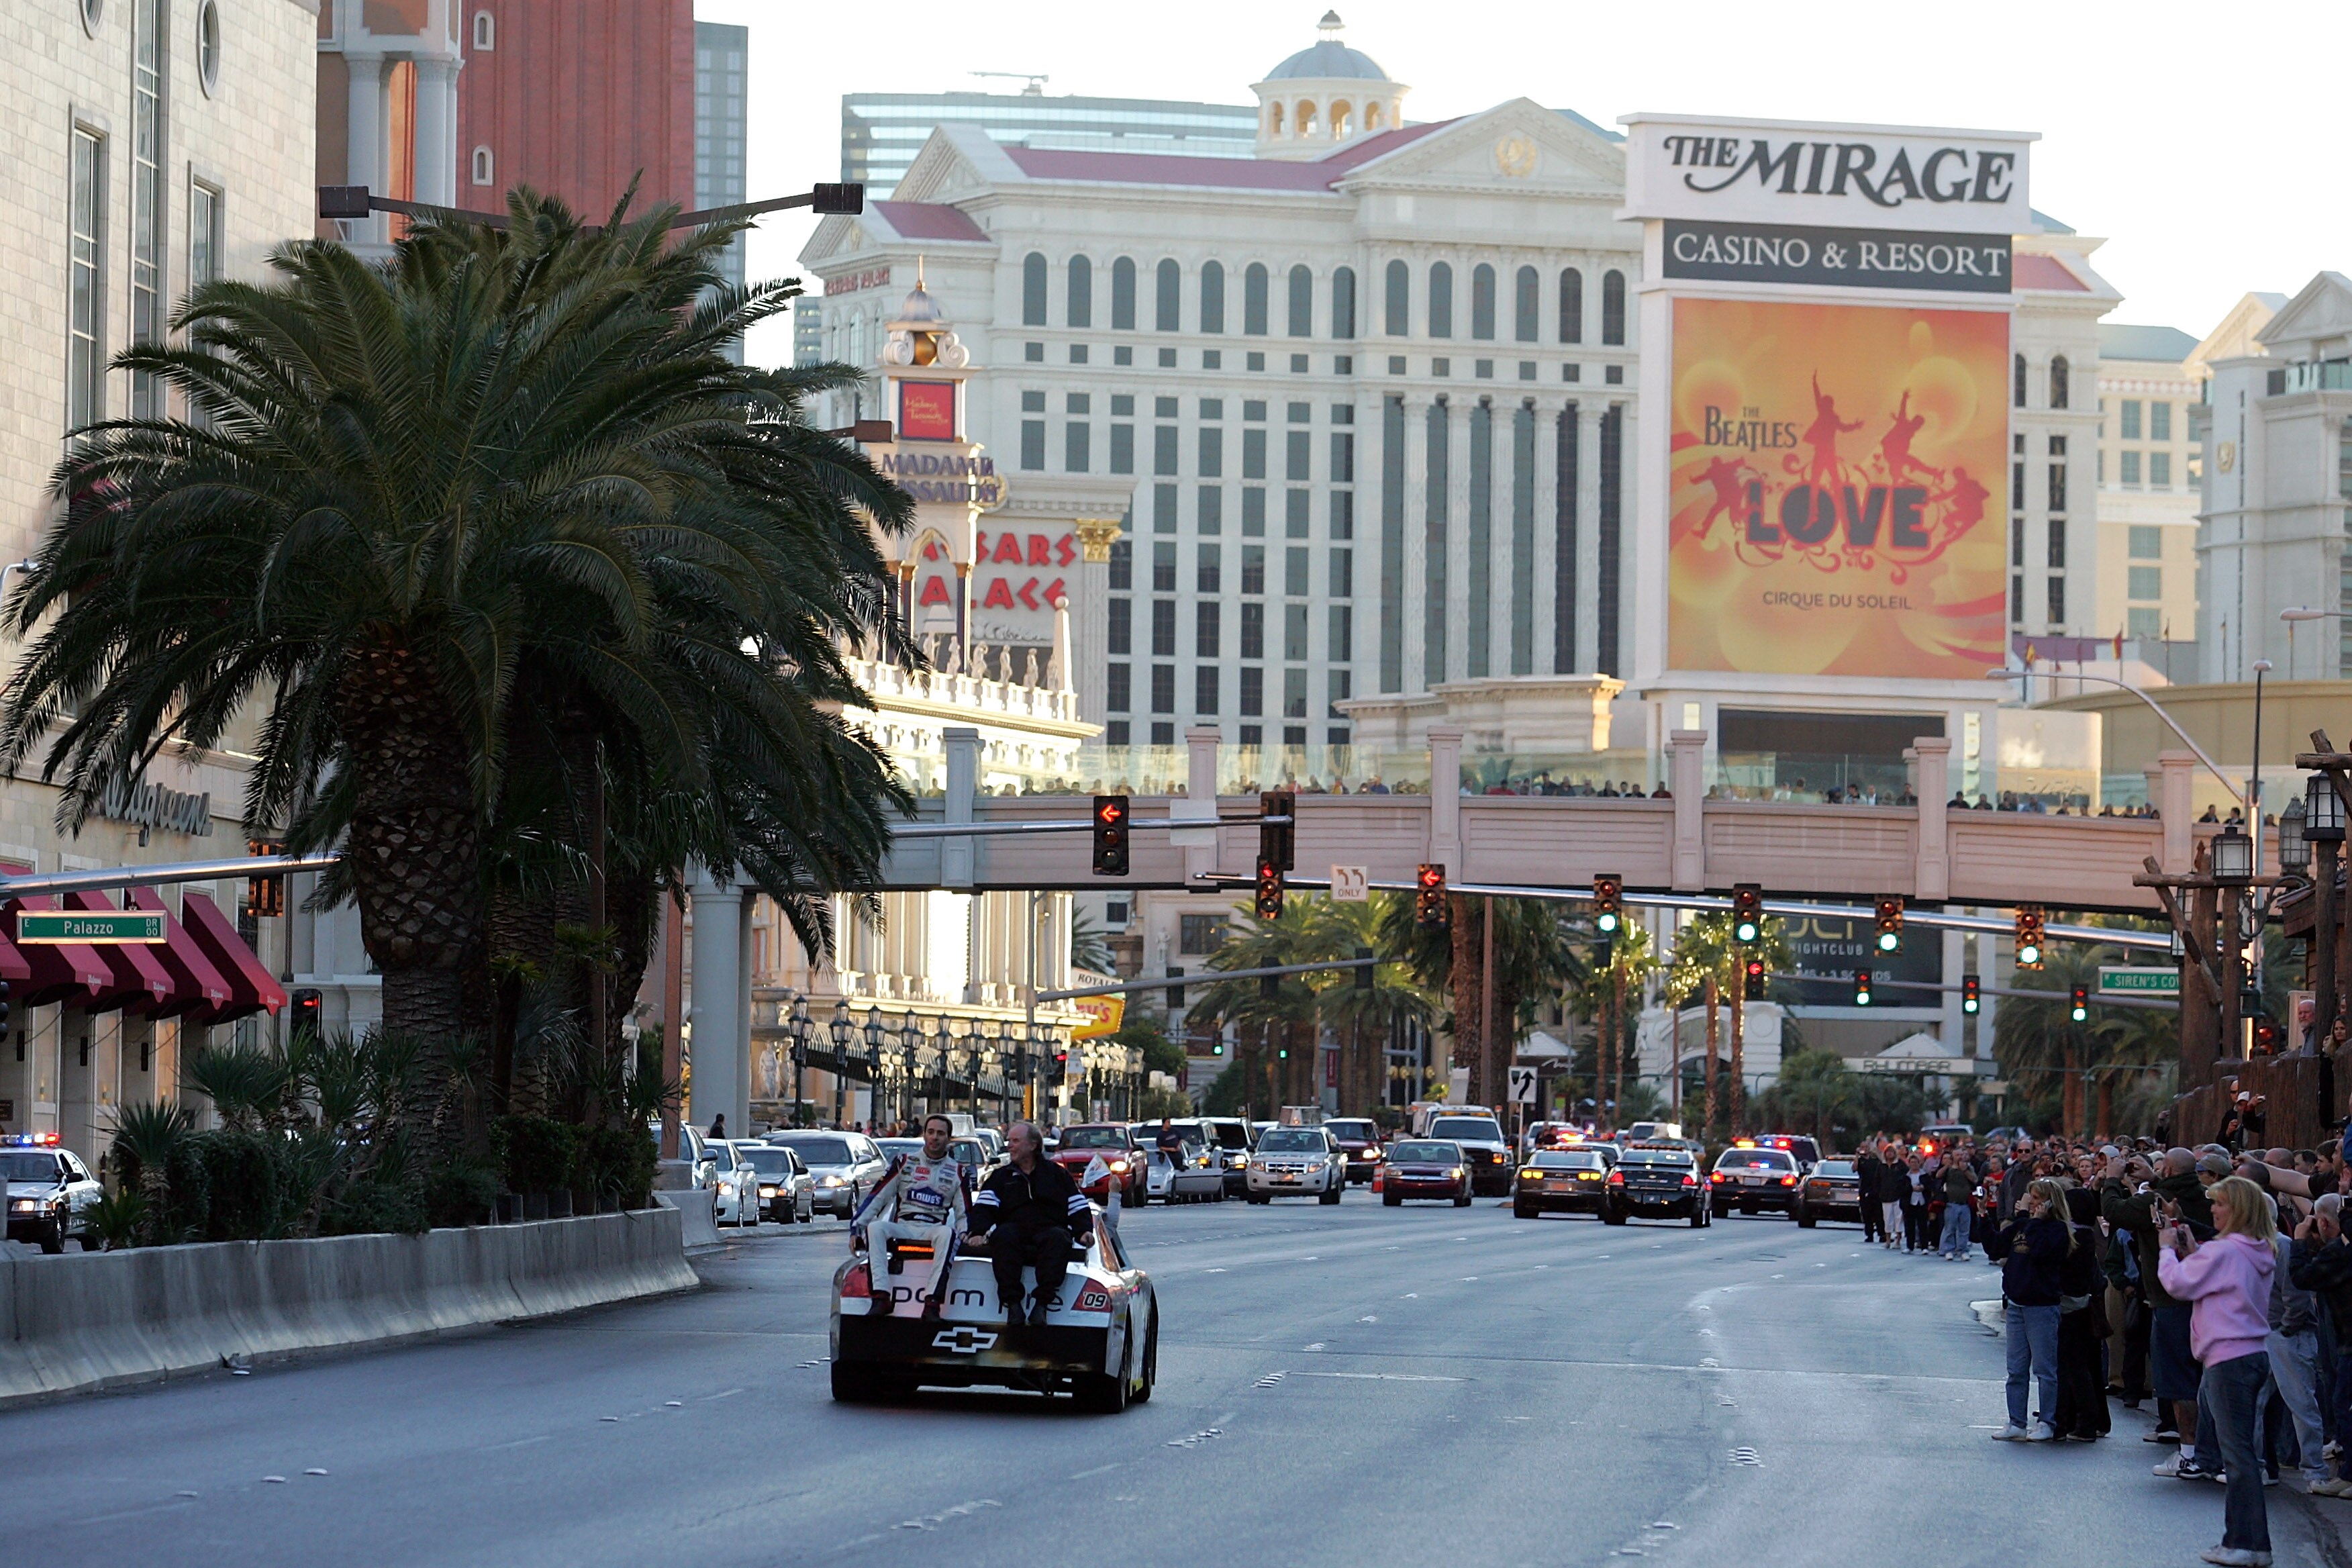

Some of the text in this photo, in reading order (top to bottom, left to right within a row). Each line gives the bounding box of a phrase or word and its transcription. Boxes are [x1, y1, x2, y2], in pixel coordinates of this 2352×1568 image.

[1664, 136, 2016, 207] THE MIRAGE
[1673, 232, 2007, 276] CASINO & RESORT
[1743, 407, 1760, 418] THE
[1704, 405, 1798, 452] BEATLES
[1747, 481, 1930, 549] LOVE
[1763, 591, 1912, 610] CIRQUE DU SOLEIL
[1338, 889, 1361, 897] ONLY
[24, 919, 158, 934] E Palazzo DR
[2115, 975, 2157, 987] SIREN'S
[911, 1190, 941, 1204] LOWE'S
